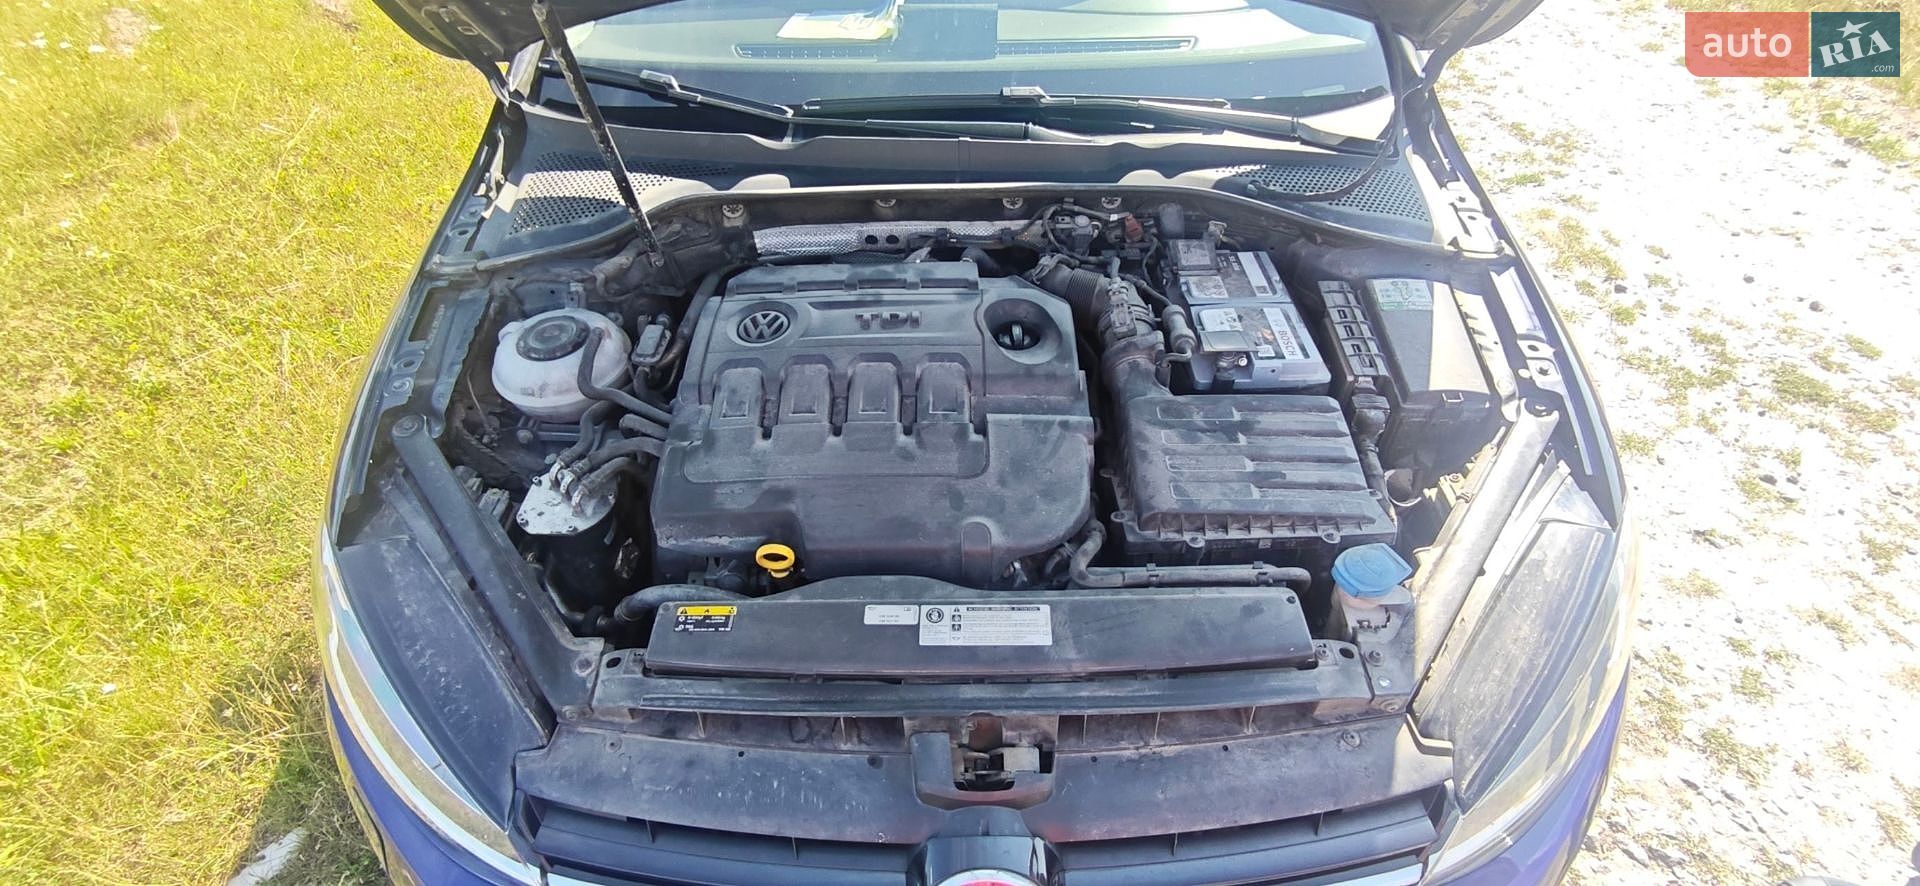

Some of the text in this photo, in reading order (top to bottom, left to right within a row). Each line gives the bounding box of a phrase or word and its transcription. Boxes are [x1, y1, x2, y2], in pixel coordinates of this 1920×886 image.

[738, 311, 790, 343] VW
[855, 311, 920, 330] TDI
[1278, 330, 1298, 357] BOSCH
